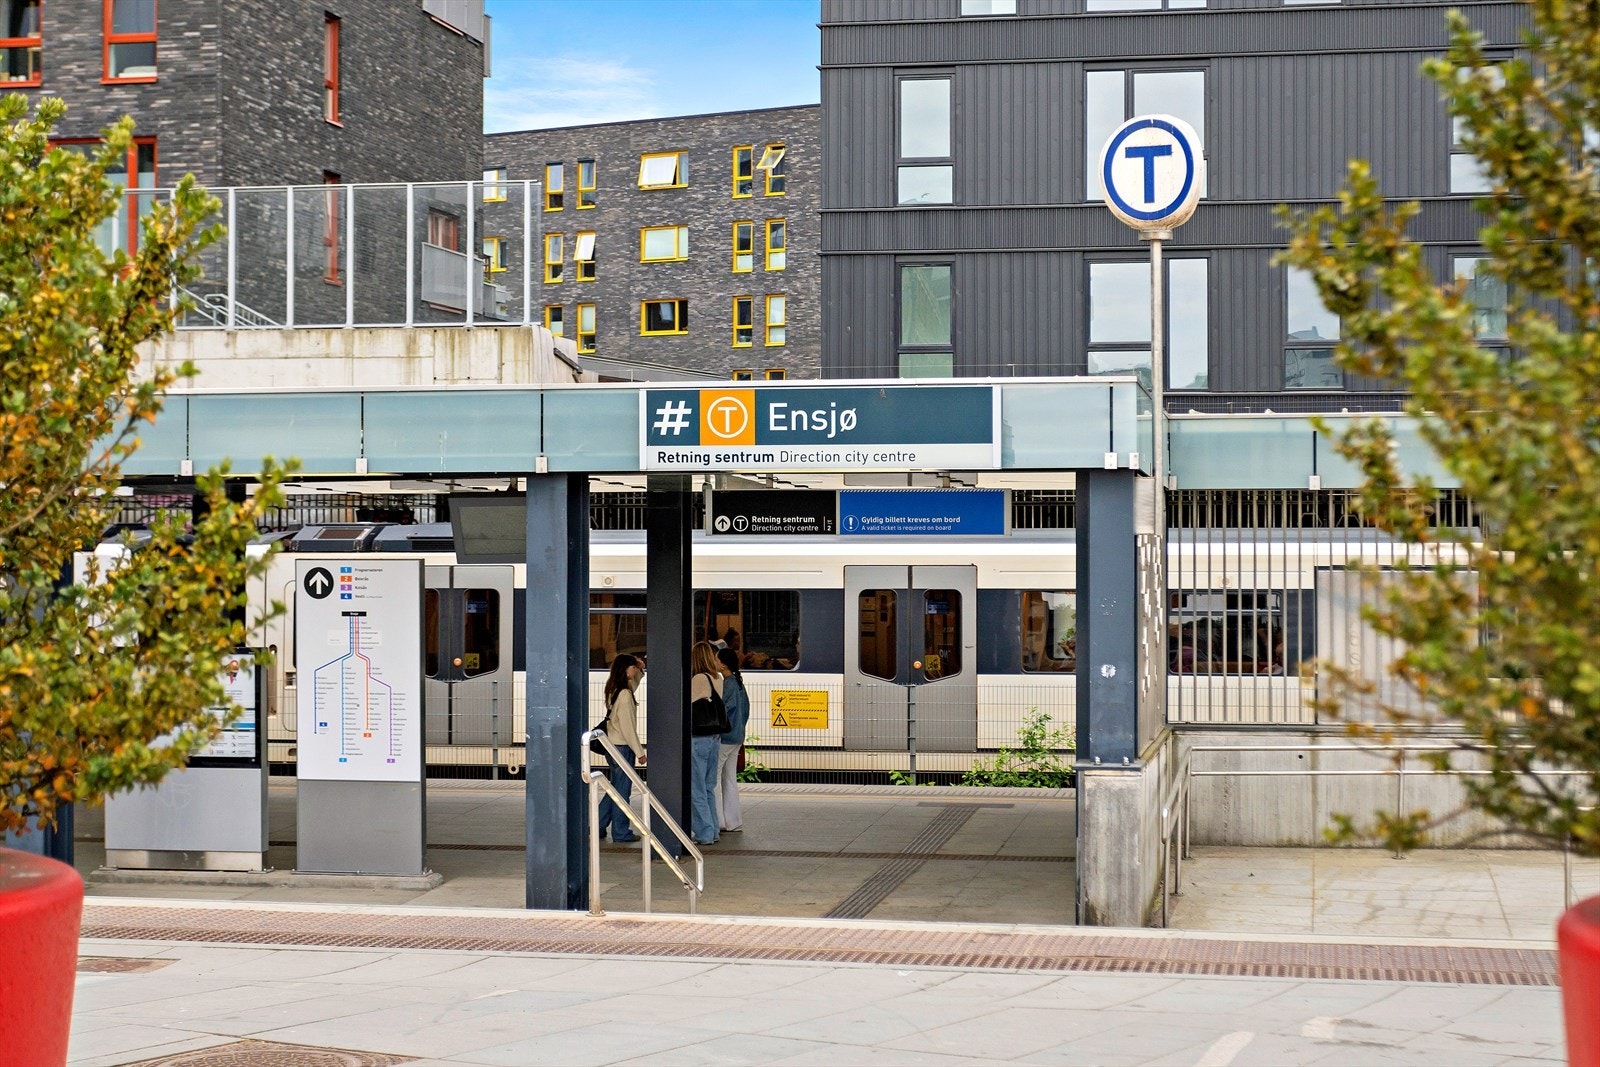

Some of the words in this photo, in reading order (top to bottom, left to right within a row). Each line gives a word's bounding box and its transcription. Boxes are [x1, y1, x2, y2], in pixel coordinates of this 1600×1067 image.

[1125, 144, 1172, 204] T
[717, 406, 738, 433] T
[769, 402, 857, 439] Ensjø
[657, 451, 711, 466] Retning
[714, 451, 775, 463] sentrum
[780, 450, 840, 463] Direction
[845, 450, 869, 466] city
[873, 451, 916, 463] centre
[751, 515, 781, 524] Retning
[861, 516, 883, 524] Gyldig
[751, 524, 782, 532] Direction
[783, 524, 796, 533] city
